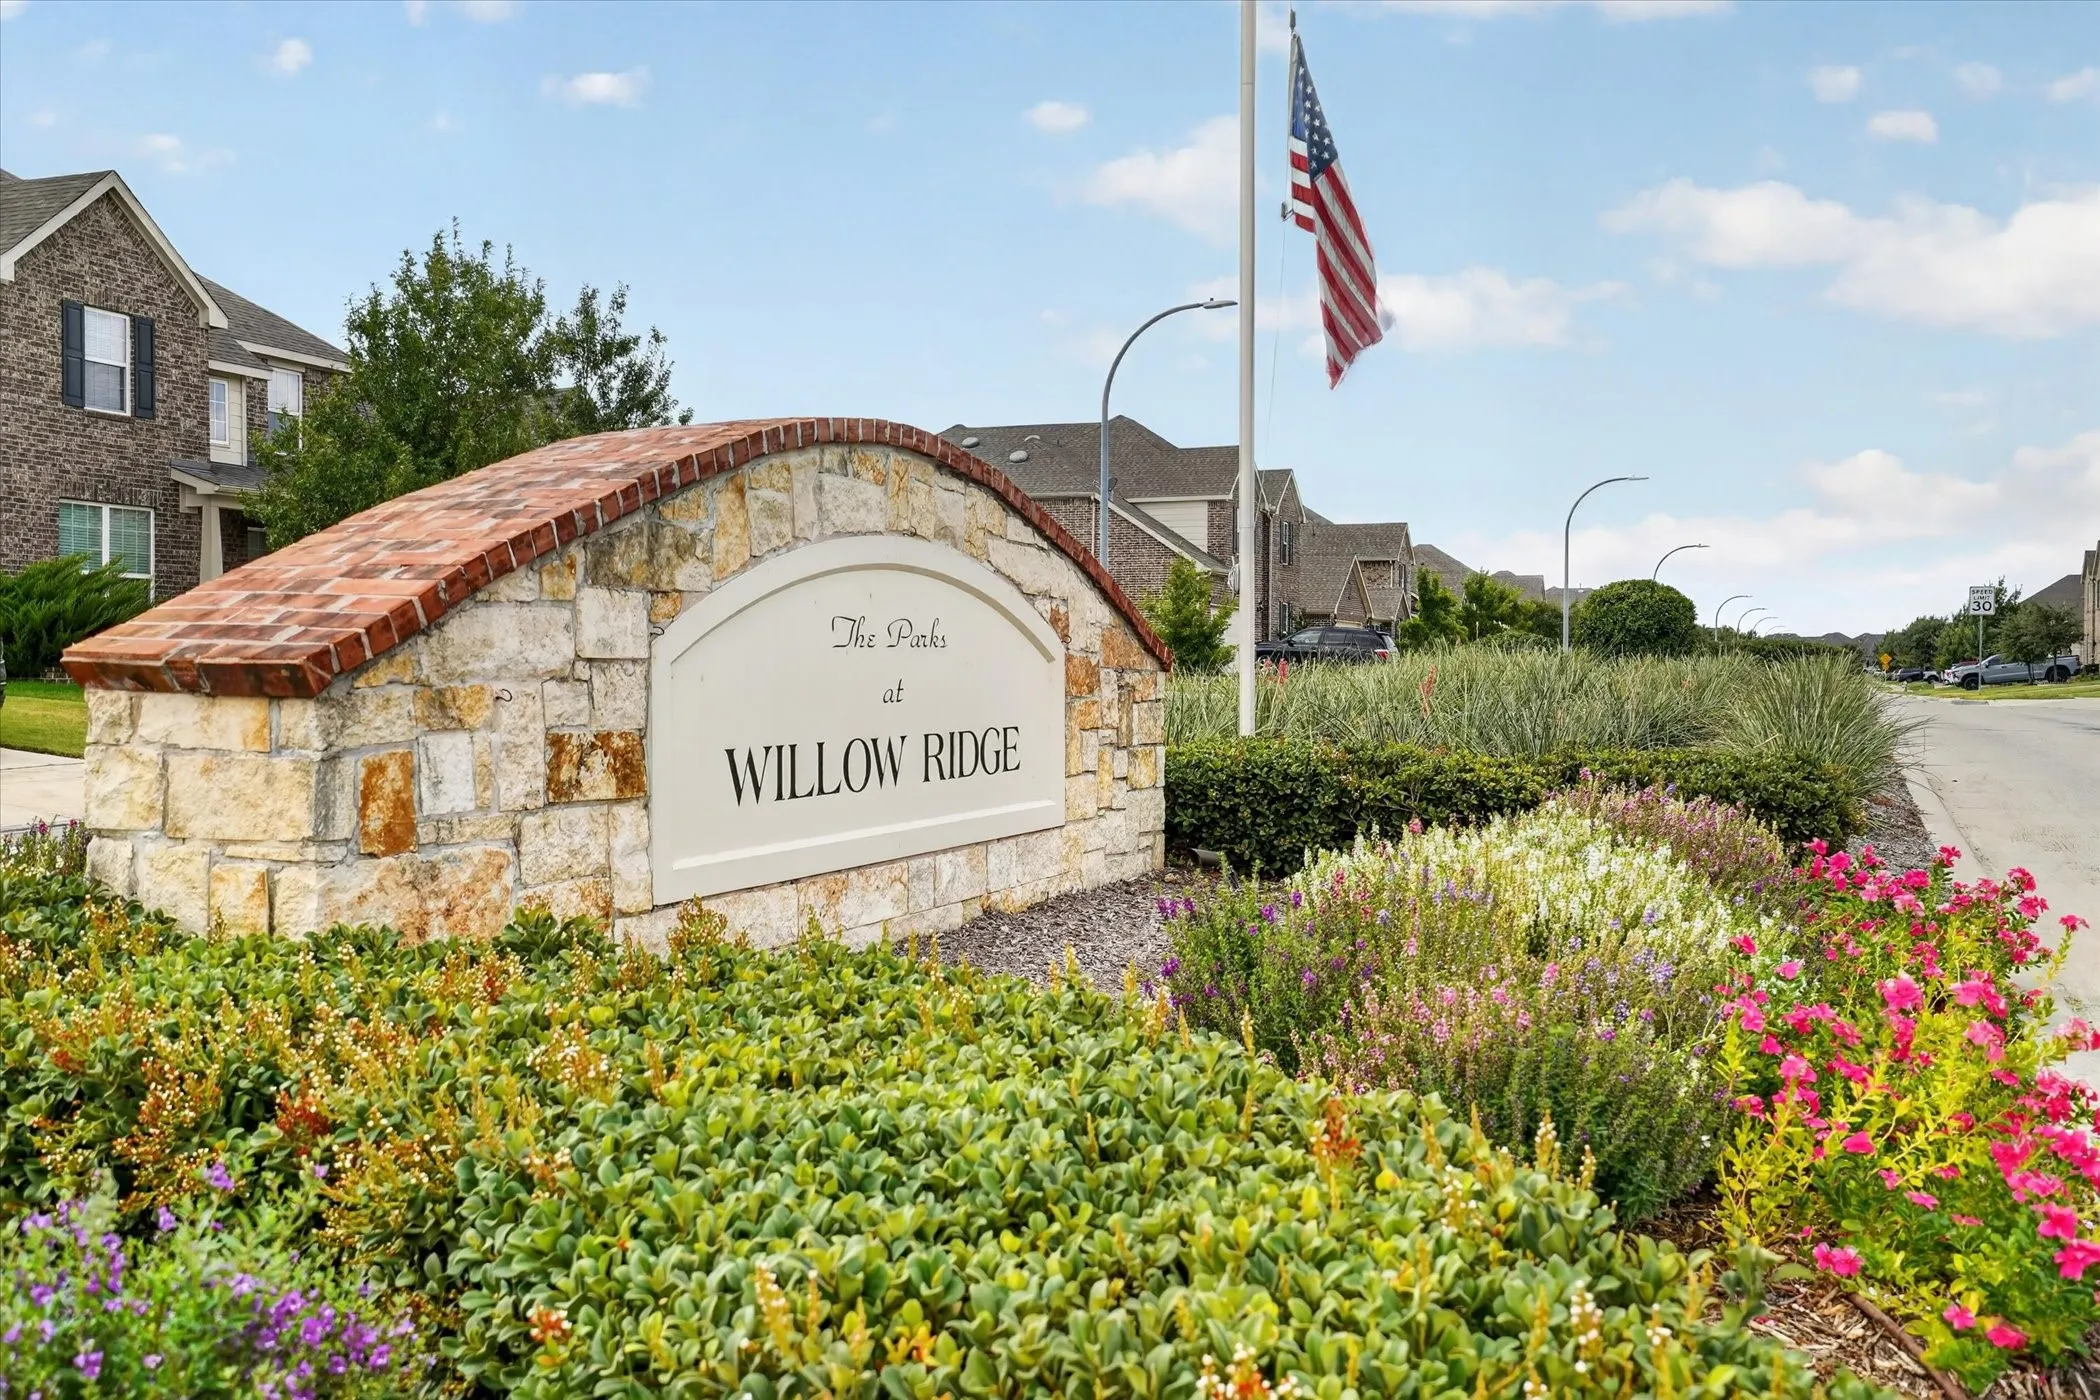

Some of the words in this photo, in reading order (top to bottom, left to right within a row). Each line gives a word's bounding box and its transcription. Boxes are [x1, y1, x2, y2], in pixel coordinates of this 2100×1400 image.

[1972, 601, 1992, 611] 30
[831, 615, 877, 649] The
[886, 618, 948, 649] Parks
[882, 678, 905, 704] at
[724, 735, 908, 807] WILLOW
[922, 726, 1022, 783] RIDGE
